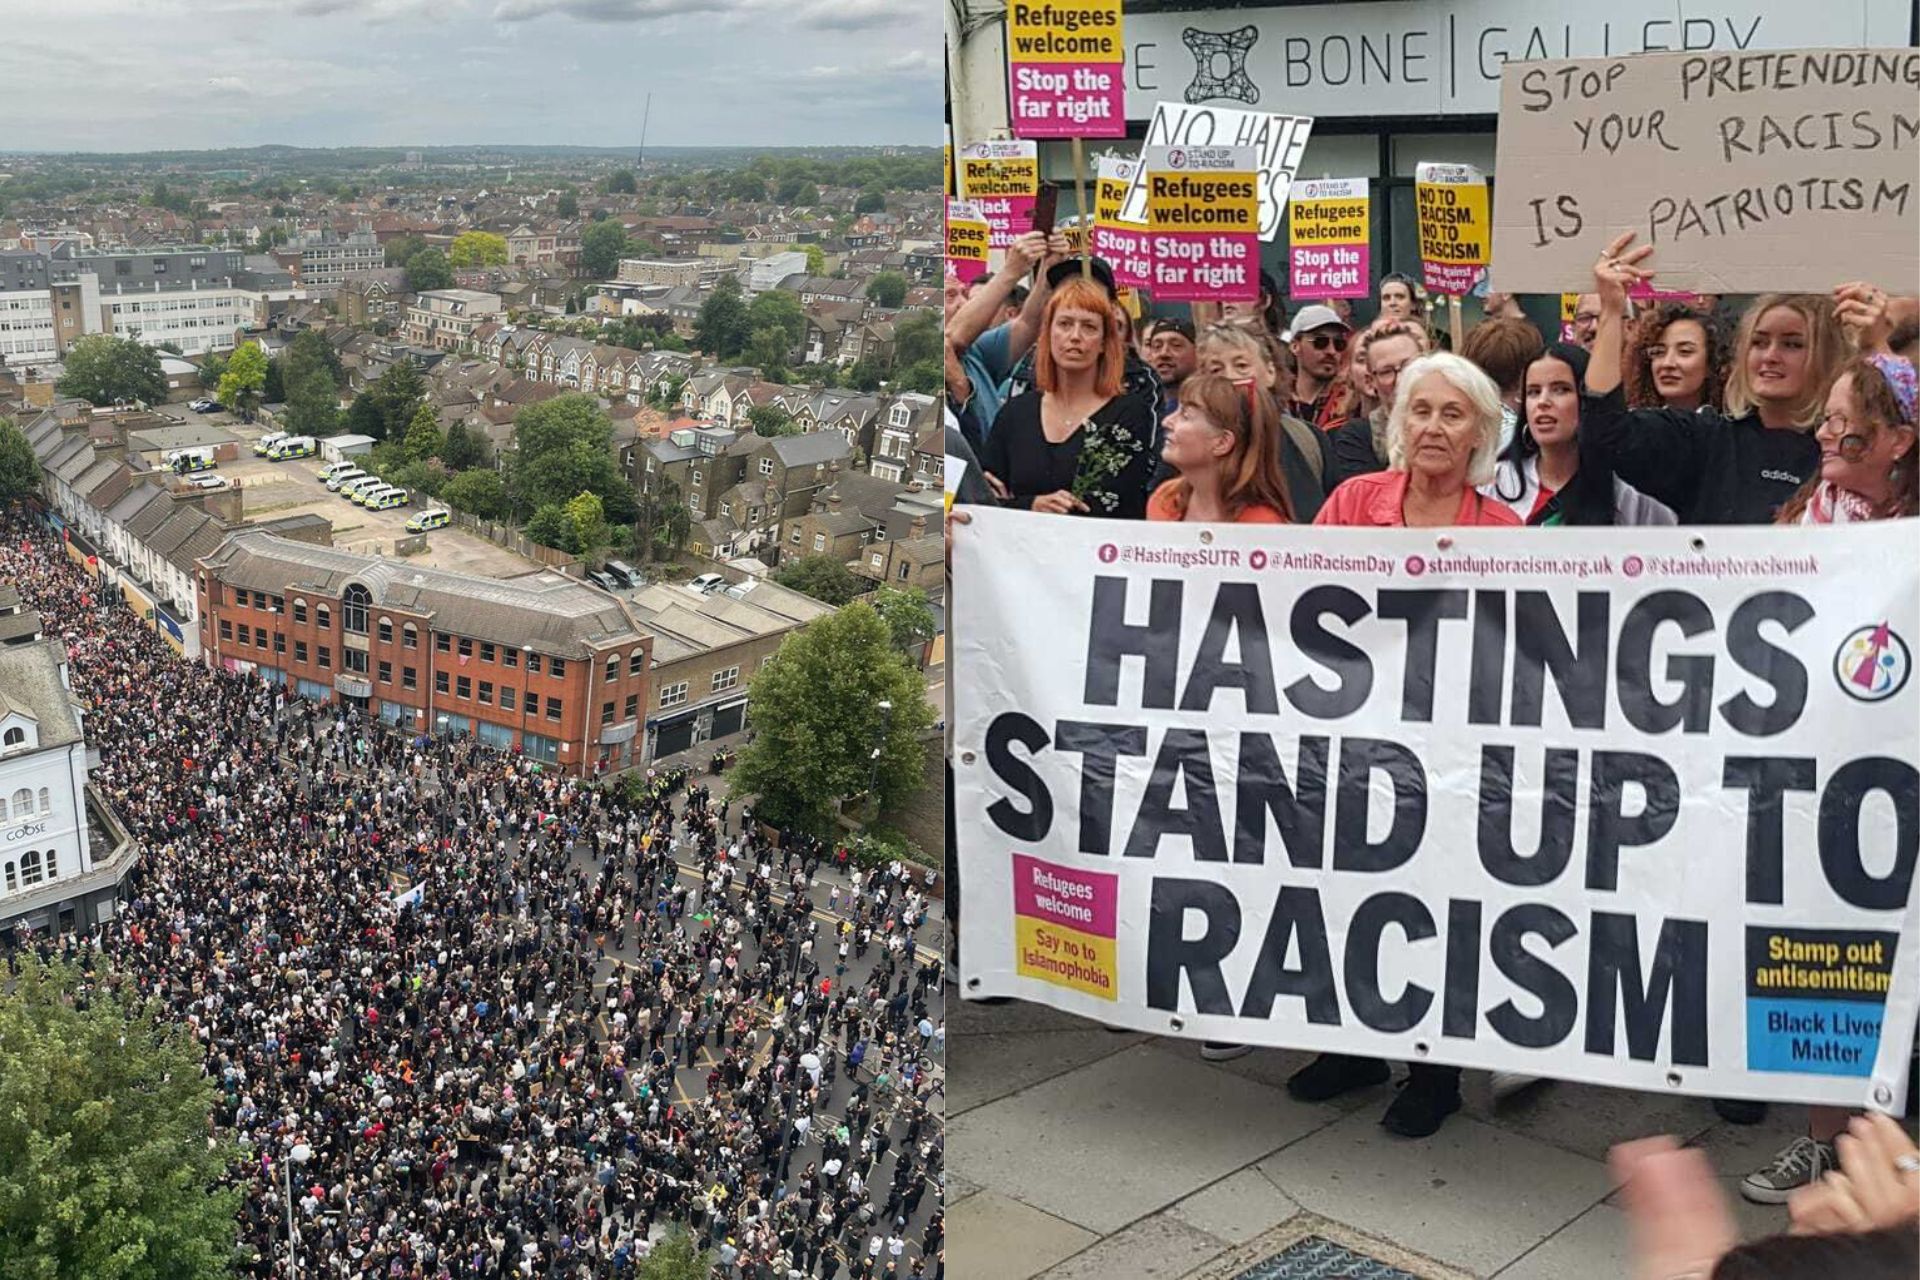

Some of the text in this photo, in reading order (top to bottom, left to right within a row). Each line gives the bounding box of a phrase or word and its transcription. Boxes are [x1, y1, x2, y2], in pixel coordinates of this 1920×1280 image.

[1015, 4, 1117, 31] Refugees
[1016, 31, 1113, 53] welcome
[1286, 31, 1429, 88] BONE
[1017, 67, 1112, 96] Stop the
[1521, 52, 1919, 112] STOP PRETENDING
[1018, 95, 1111, 123] far right
[1235, 114, 1311, 171] HATE
[1573, 109, 1680, 156] YOUR
[966, 163, 1033, 180] Refugees
[968, 181, 1031, 194] welcome
[1153, 177, 1253, 203] Refugees
[1419, 187, 1456, 206] NO TO
[1154, 203, 1249, 224] welcome
[1294, 203, 1365, 223] Refugees
[1528, 178, 1910, 248] IS PATRIOTISM
[949, 227, 985, 243] gees
[1097, 230, 1136, 255] Stop
[1294, 223, 1361, 239] welcome
[1422, 223, 1459, 242] NO TO
[1155, 237, 1204, 262] Stop
[1210, 237, 1246, 258] the
[1294, 247, 1360, 269] Stop the
[1423, 240, 1480, 260] FASCISM
[1155, 263, 1246, 289] far right
[1294, 267, 1359, 288] far right
[1761, 469, 1800, 484] adidas
[1121, 546, 1819, 579] @HastingsSUTR @AntiRacismDay standuptoracism.org.uk @standuptoracismuk
[1083, 574, 1816, 738] HASTINGS
[984, 711, 1919, 911] STAND UP TO
[1032, 866, 1093, 900] Refugees
[1035, 893, 1092, 922] welcome
[1036, 928, 1096, 962] Say no to
[1768, 935, 1883, 966] Stamp out
[1023, 947, 1110, 988] Islamophobia
[1144, 874, 1709, 1069] RACISM
[1767, 1010, 1825, 1035] Black
[1791, 1038, 1863, 1063] Matter
